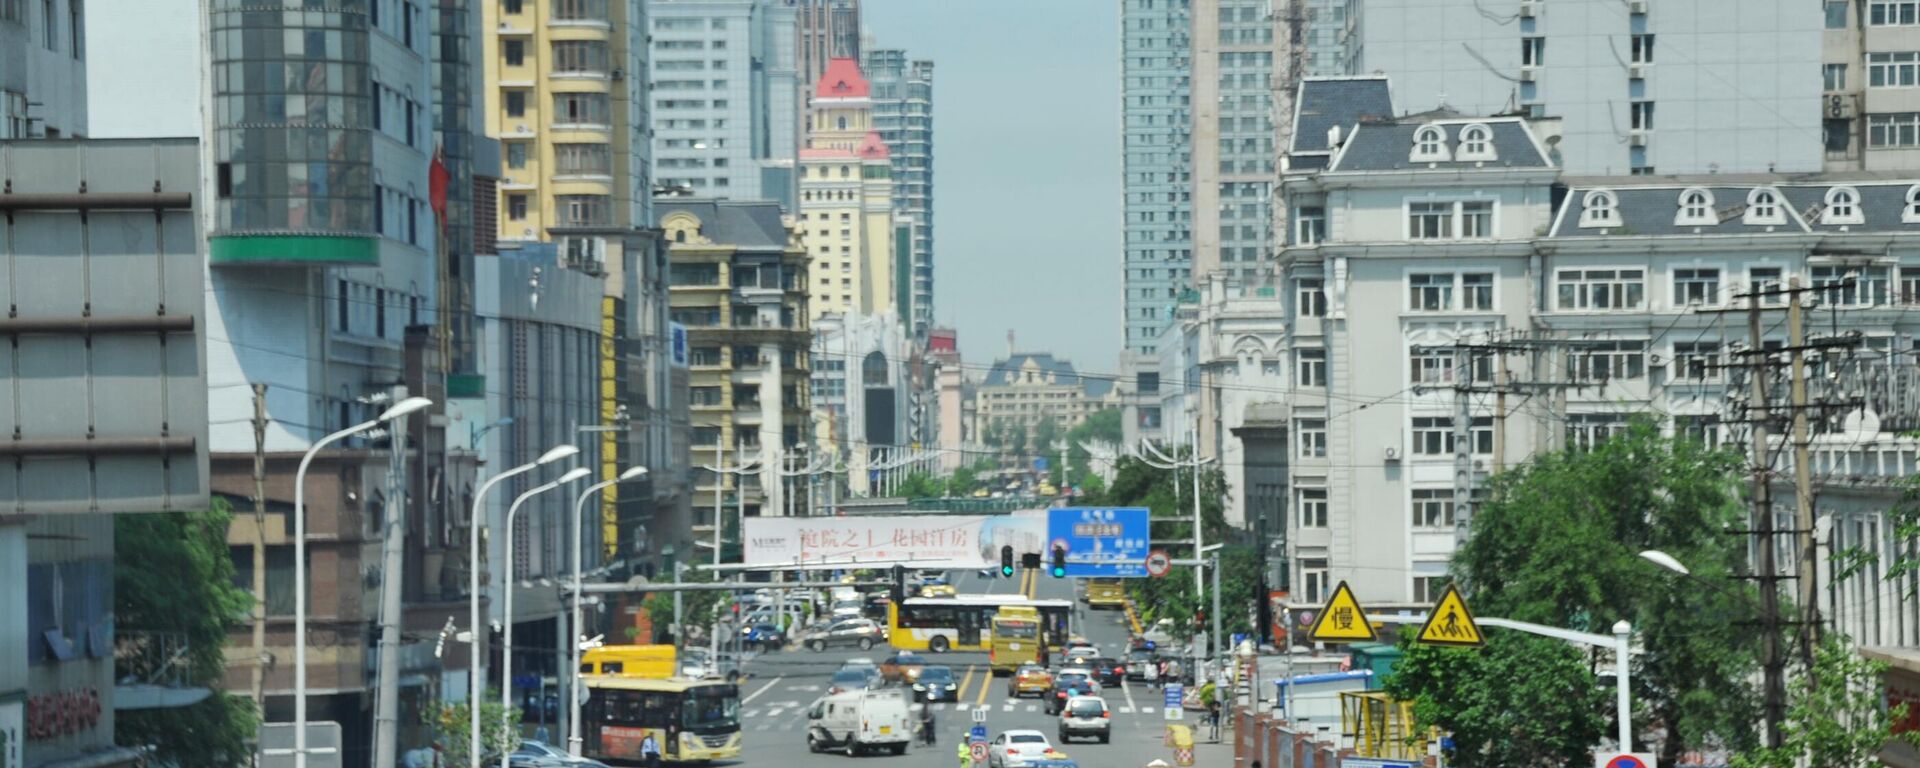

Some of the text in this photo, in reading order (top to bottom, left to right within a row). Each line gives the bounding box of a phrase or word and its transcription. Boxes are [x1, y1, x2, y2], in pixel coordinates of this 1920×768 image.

[891, 527, 968, 548] 花园洋房
[1332, 607, 1353, 630] 慢
